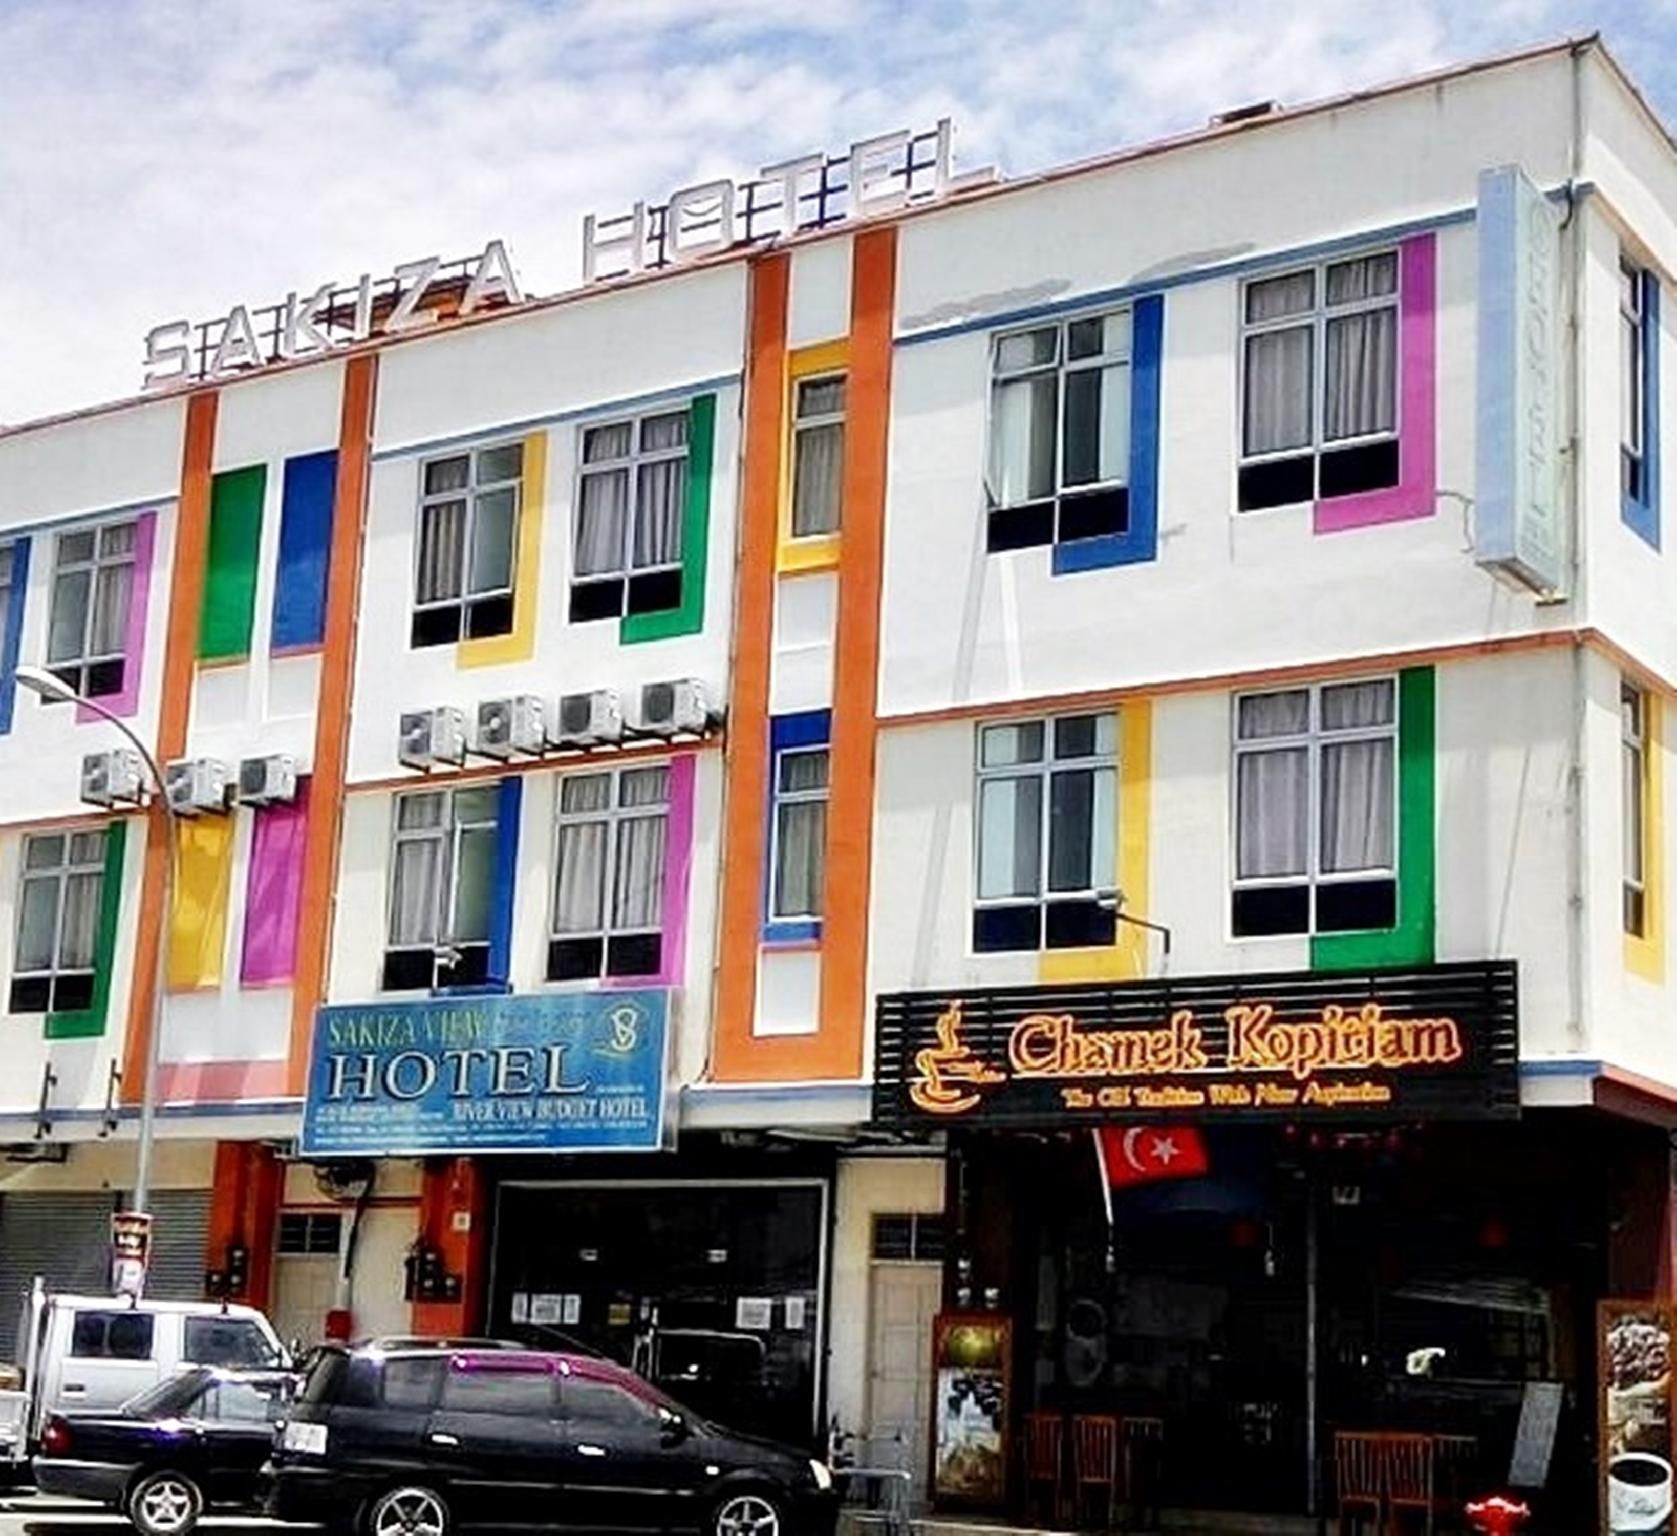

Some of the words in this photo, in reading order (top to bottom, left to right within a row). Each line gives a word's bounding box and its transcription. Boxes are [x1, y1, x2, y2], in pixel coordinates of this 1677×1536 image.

[142, 238, 528, 389] SAKIZA
[582, 117, 1002, 284] HOTEL
[327, 1044, 591, 1099] HOTEL
[1009, 1010, 1209, 1076] Chamek
[1224, 1003, 1463, 1080] Kopitiam
[599, 1096, 647, 1119] HOTEL
